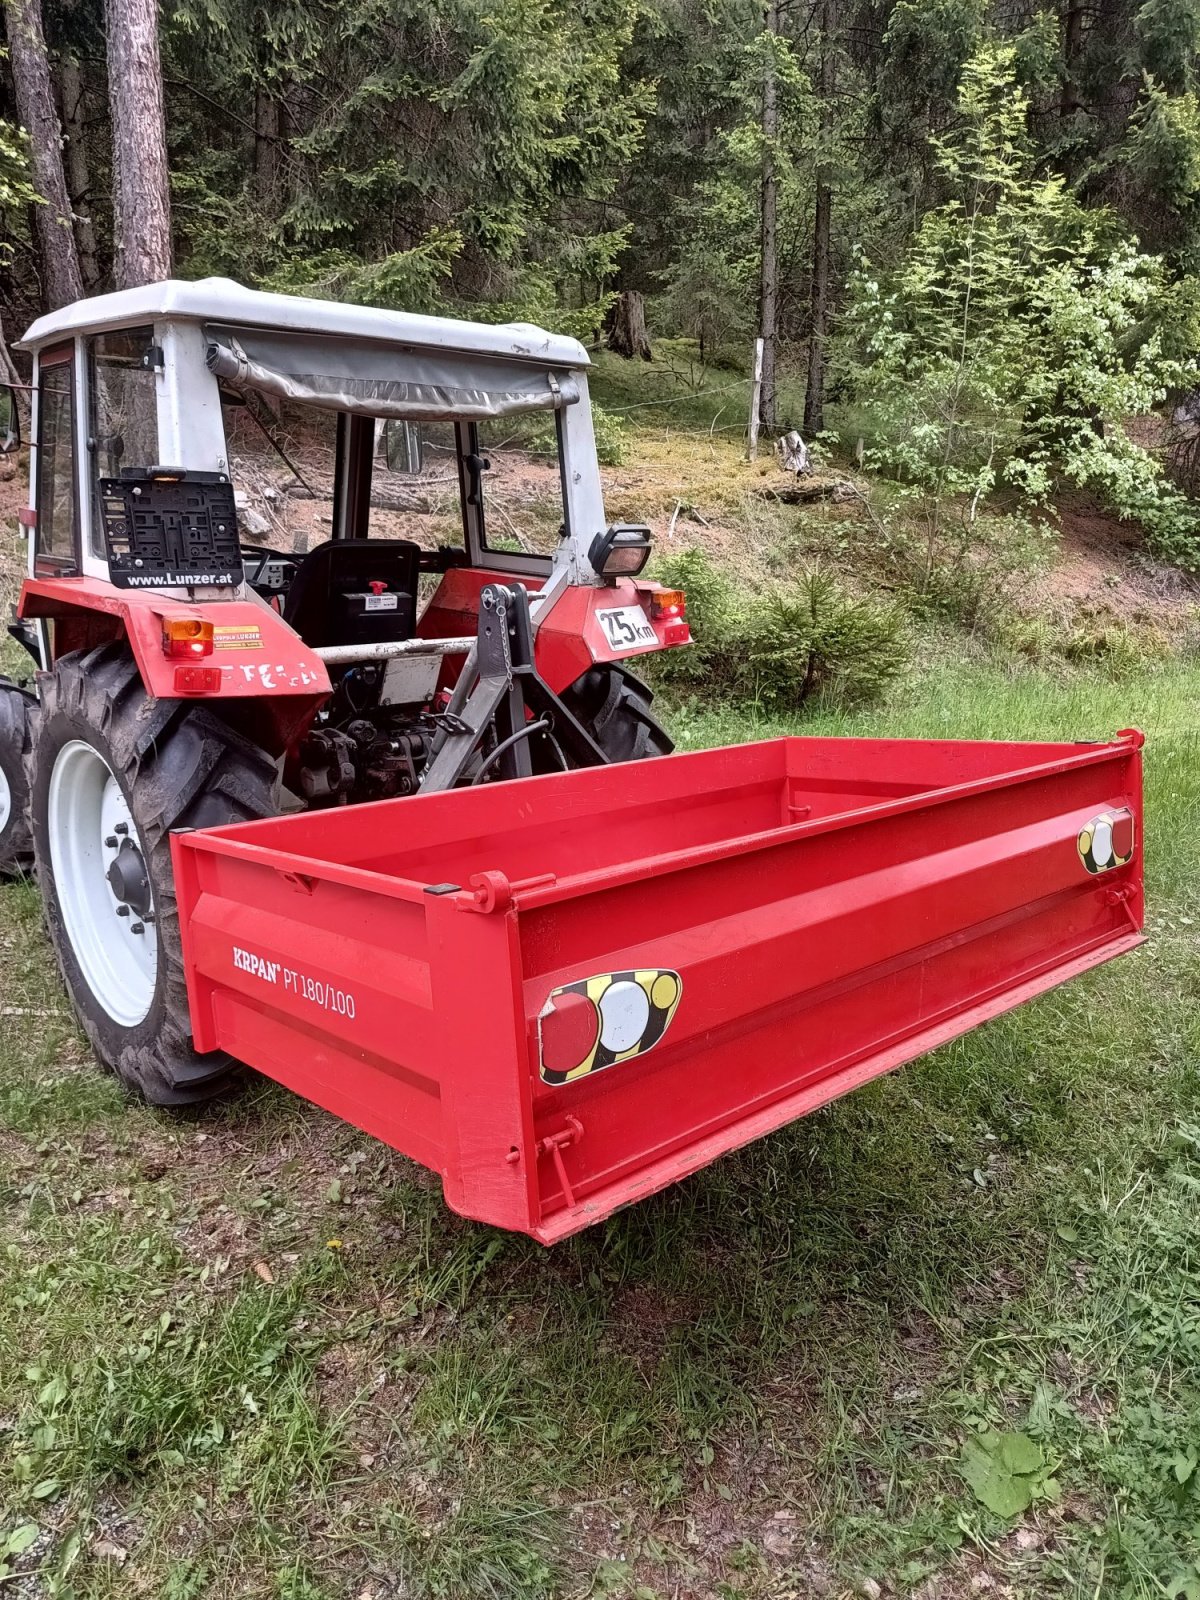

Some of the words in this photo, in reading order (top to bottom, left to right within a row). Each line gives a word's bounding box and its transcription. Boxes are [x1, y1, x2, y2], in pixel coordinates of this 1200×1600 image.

[127, 573, 232, 586] www.Lunzer.at
[600, 611, 636, 645] 25
[632, 622, 655, 639] km
[283, 967, 299, 993] PT
[300, 975, 355, 1018] 180/100
